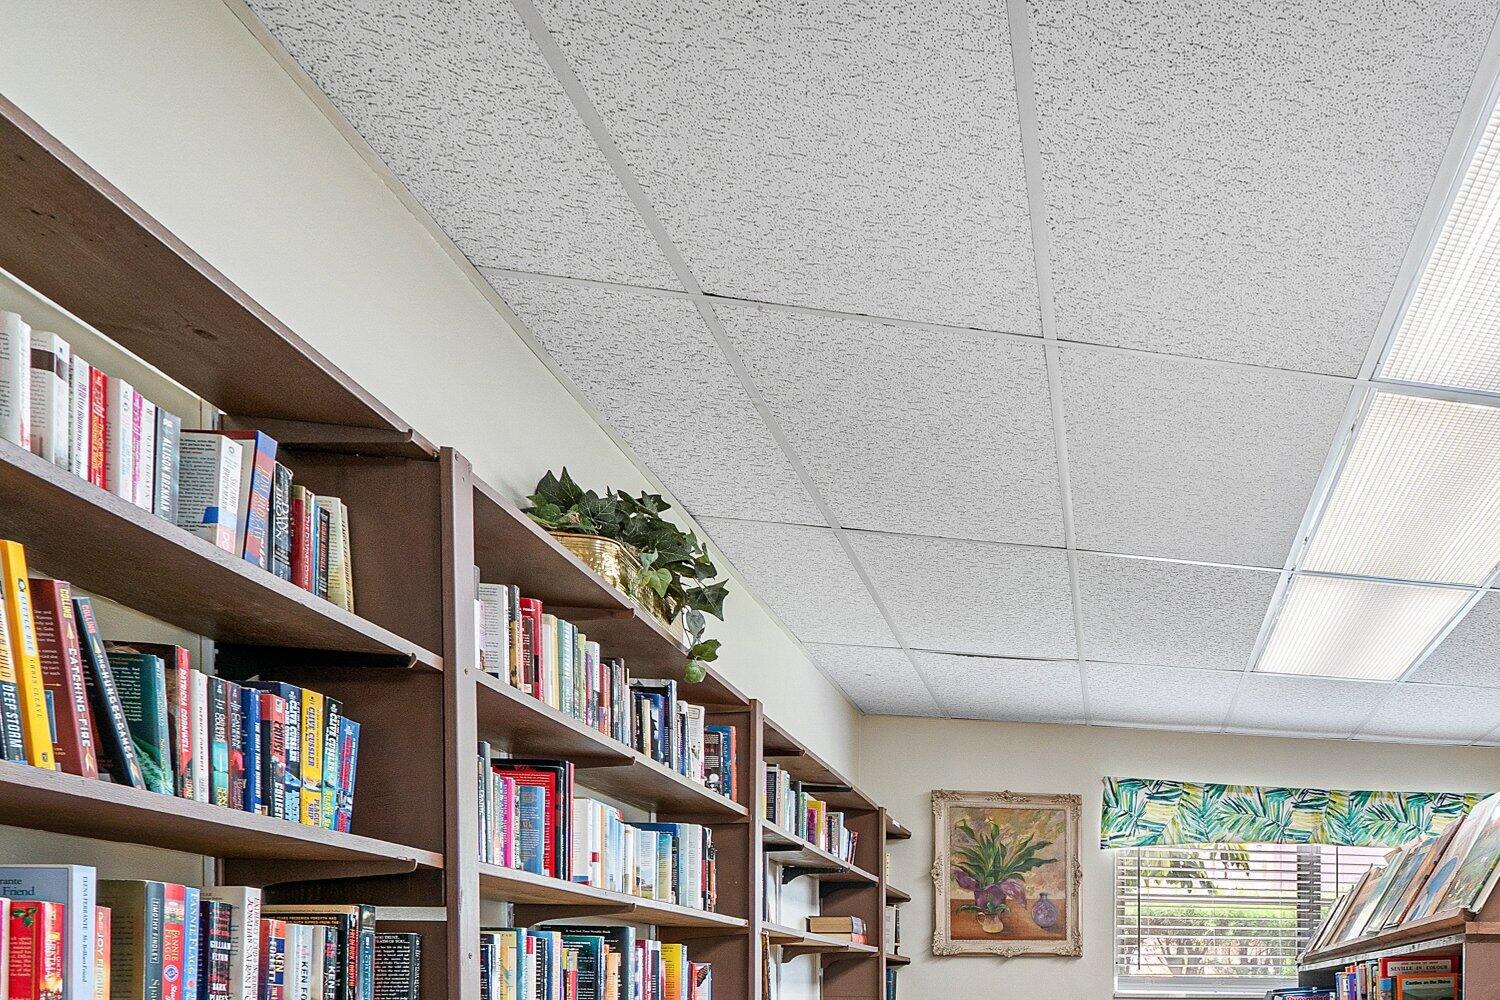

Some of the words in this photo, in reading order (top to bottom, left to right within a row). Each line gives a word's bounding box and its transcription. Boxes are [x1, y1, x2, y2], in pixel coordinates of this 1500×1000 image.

[163, 437, 172, 470] ALLISON
[159, 471, 171, 511] BRENNAN
[59, 588, 72, 619] COLLINS
[81, 604, 97, 634] COLLINS
[1, 684, 16, 712] DEEP
[69, 647, 83, 713] CATCHING
[77, 718, 91, 748] FIRE
[180, 668, 189, 706] PATRICIA
[4, 714, 23, 749] STORM
[179, 707, 189, 753] CORNWELL
[3, 887, 36, 896] Friend
[171, 930, 180, 961] FANNIE
[210, 942, 231, 950] GILLIAN
[276, 953, 284, 972] KEN
